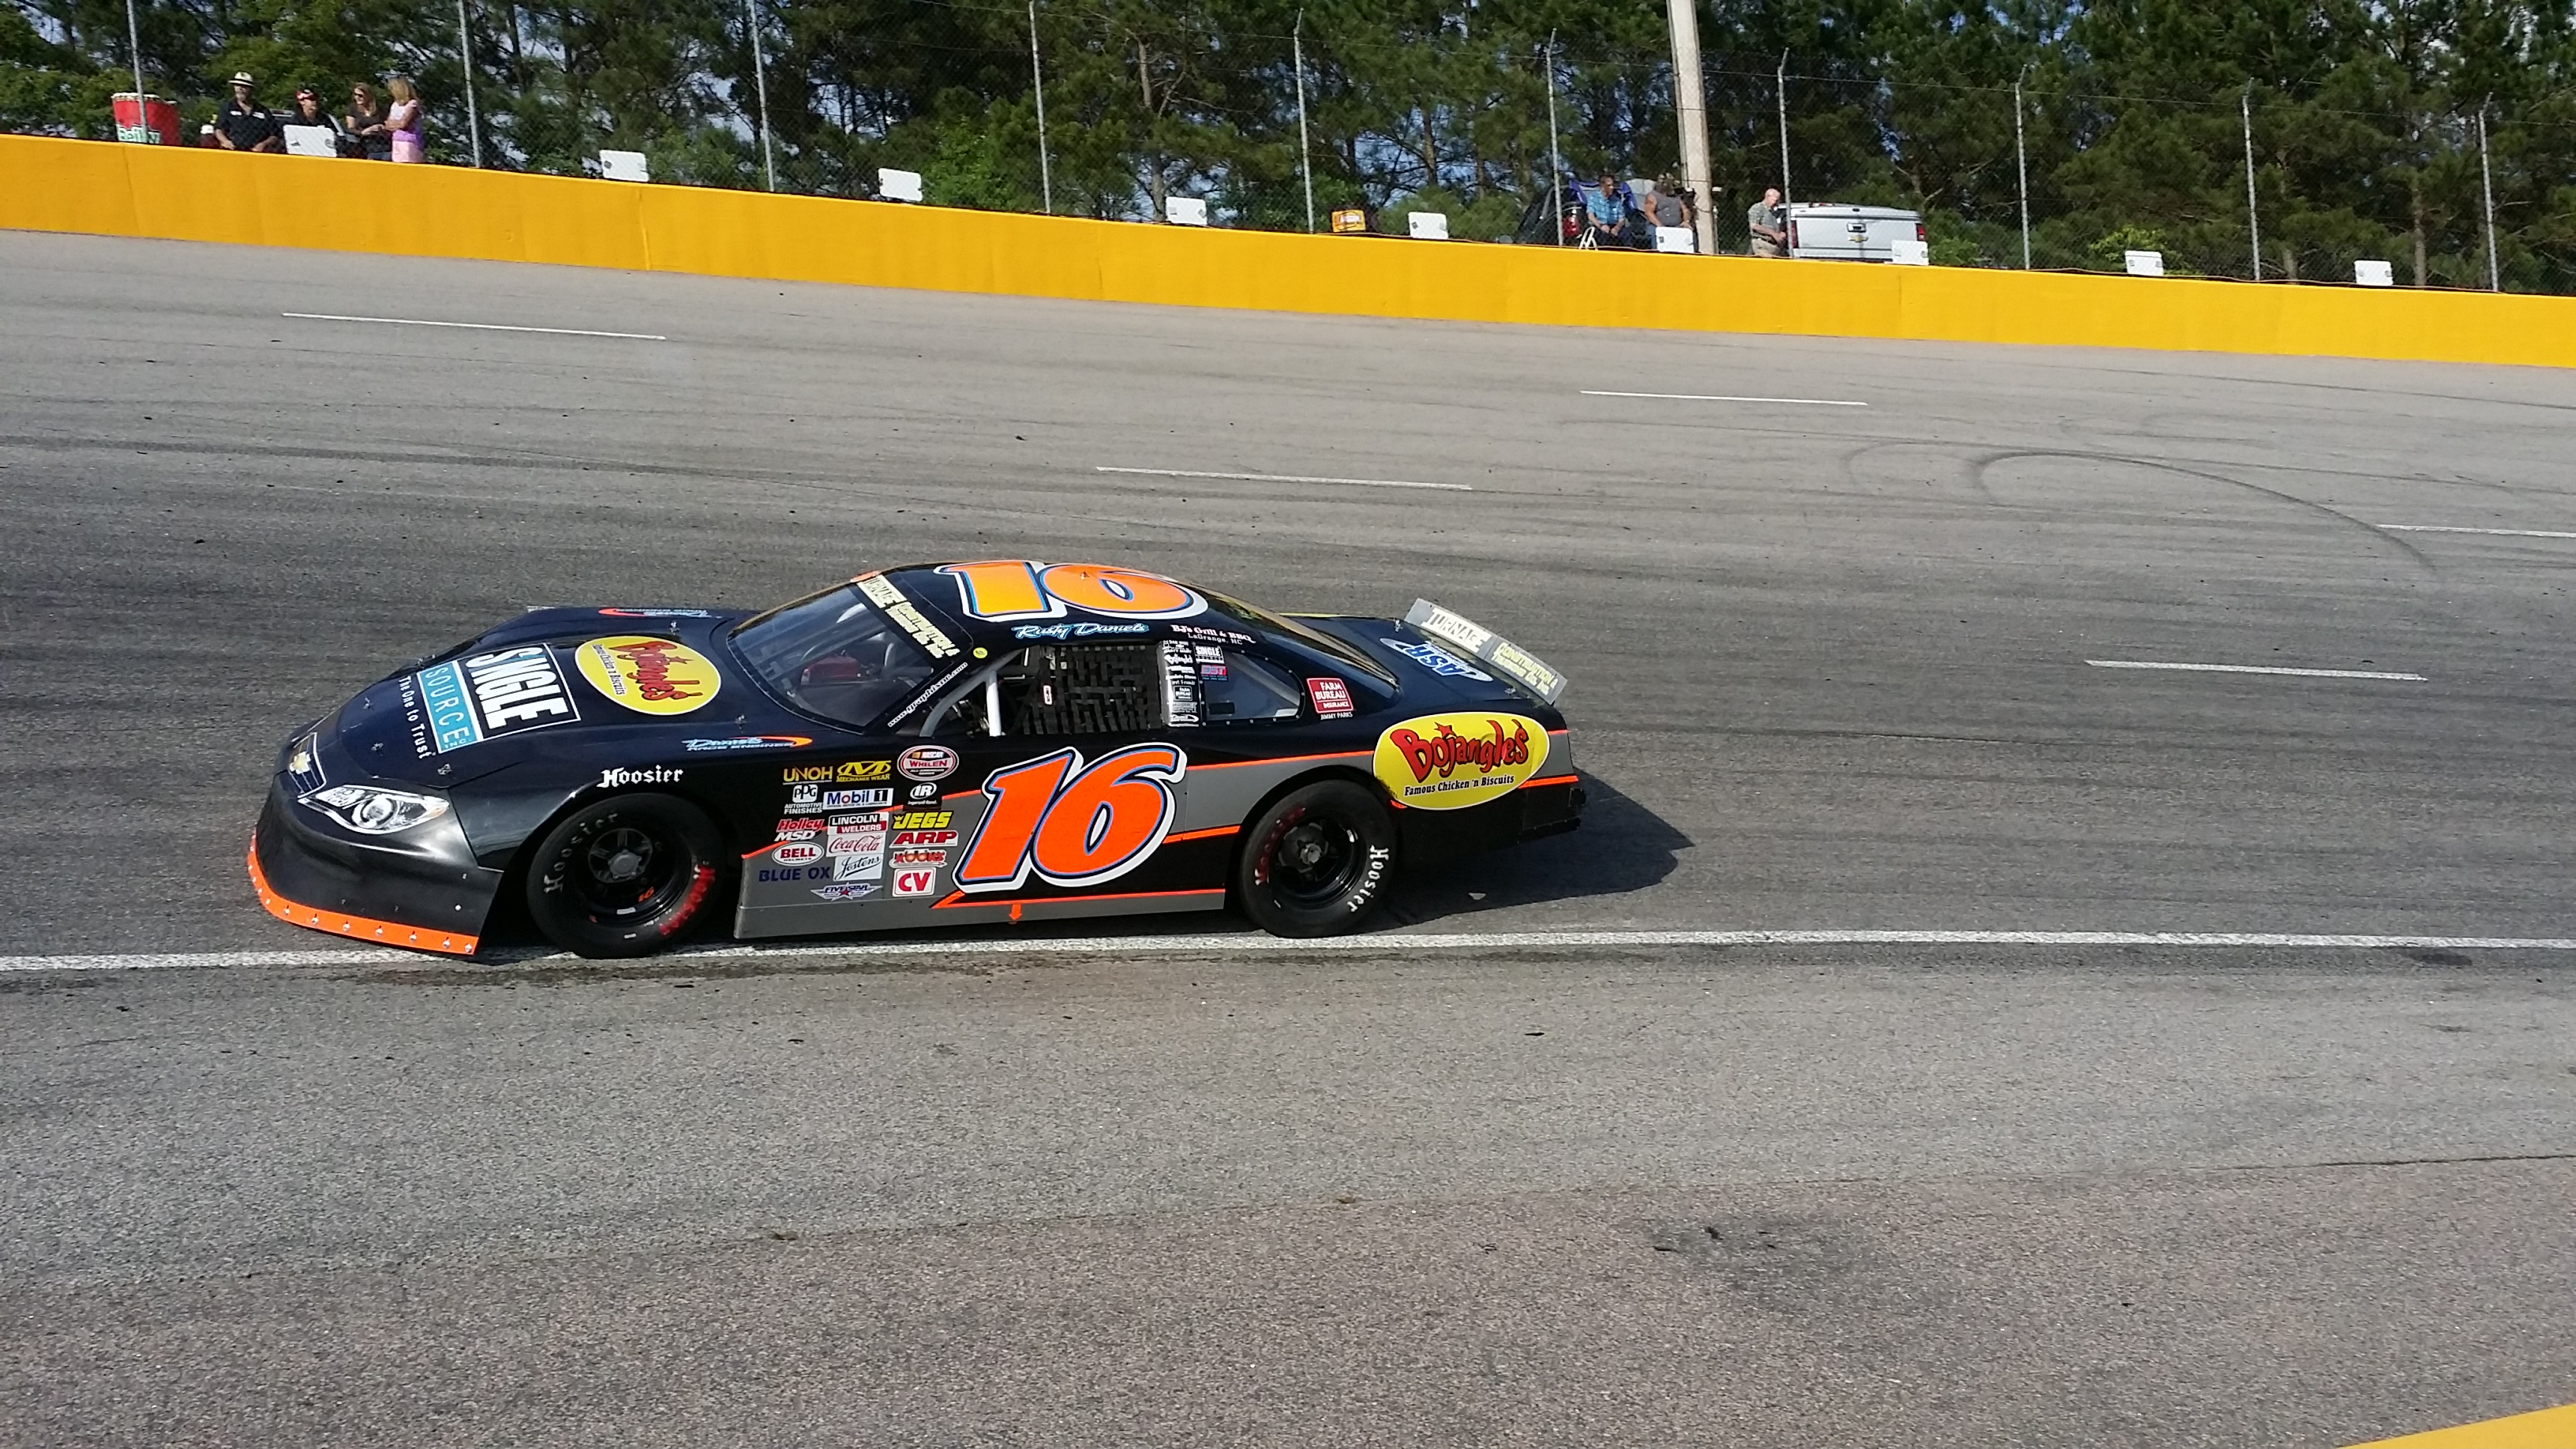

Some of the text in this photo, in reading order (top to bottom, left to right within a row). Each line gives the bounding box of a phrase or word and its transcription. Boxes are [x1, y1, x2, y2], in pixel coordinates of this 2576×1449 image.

[934, 560, 1208, 622] 16
[1011, 622, 1149, 639] Rusty Daniels
[1170, 624, 1193, 633] BJ's
[1193, 627, 1218, 636] Grill
[1227, 631, 1256, 644] BBQ
[1421, 608, 1492, 653] TURNAGE
[1195, 646, 1221, 656] SINGLE
[1403, 644, 1469, 675] ASR
[1493, 642, 1555, 685] CONSTRUCTION
[466, 647, 568, 729] SINGLE
[1320, 682, 1343, 691] FARM
[1315, 691, 1346, 700] BUREAU
[425, 667, 470, 743] SOURCE
[399, 675, 433, 759] The One to Trust
[444, 738, 471, 749] INC.
[597, 765, 684, 788] Hoosier
[783, 766, 833, 782] UNOH
[793, 784, 818, 800] PPG
[914, 785, 933, 796] IR
[1404, 785, 1436, 796] Famous
[1437, 780, 1470, 792] Chicken
[1481, 774, 1515, 786] Biscuits
[826, 790, 870, 805] Mobil
[784, 806, 823, 815] FINISHES
[953, 742, 1188, 893] 16
[776, 817, 826, 833] Holley
[831, 814, 878, 826] LINCOLN
[841, 824, 882, 833] WELDERS
[893, 812, 953, 829] JEGS
[773, 829, 816, 842] MSD
[893, 831, 957, 845] ARP
[544, 813, 618, 893] Hoosier
[781, 847, 816, 859] BELL
[758, 867, 830, 882] BLUE OX
[834, 856, 881, 881] Jostens
[898, 871, 932, 892] CV
[1346, 844, 1389, 912] Hoosier
